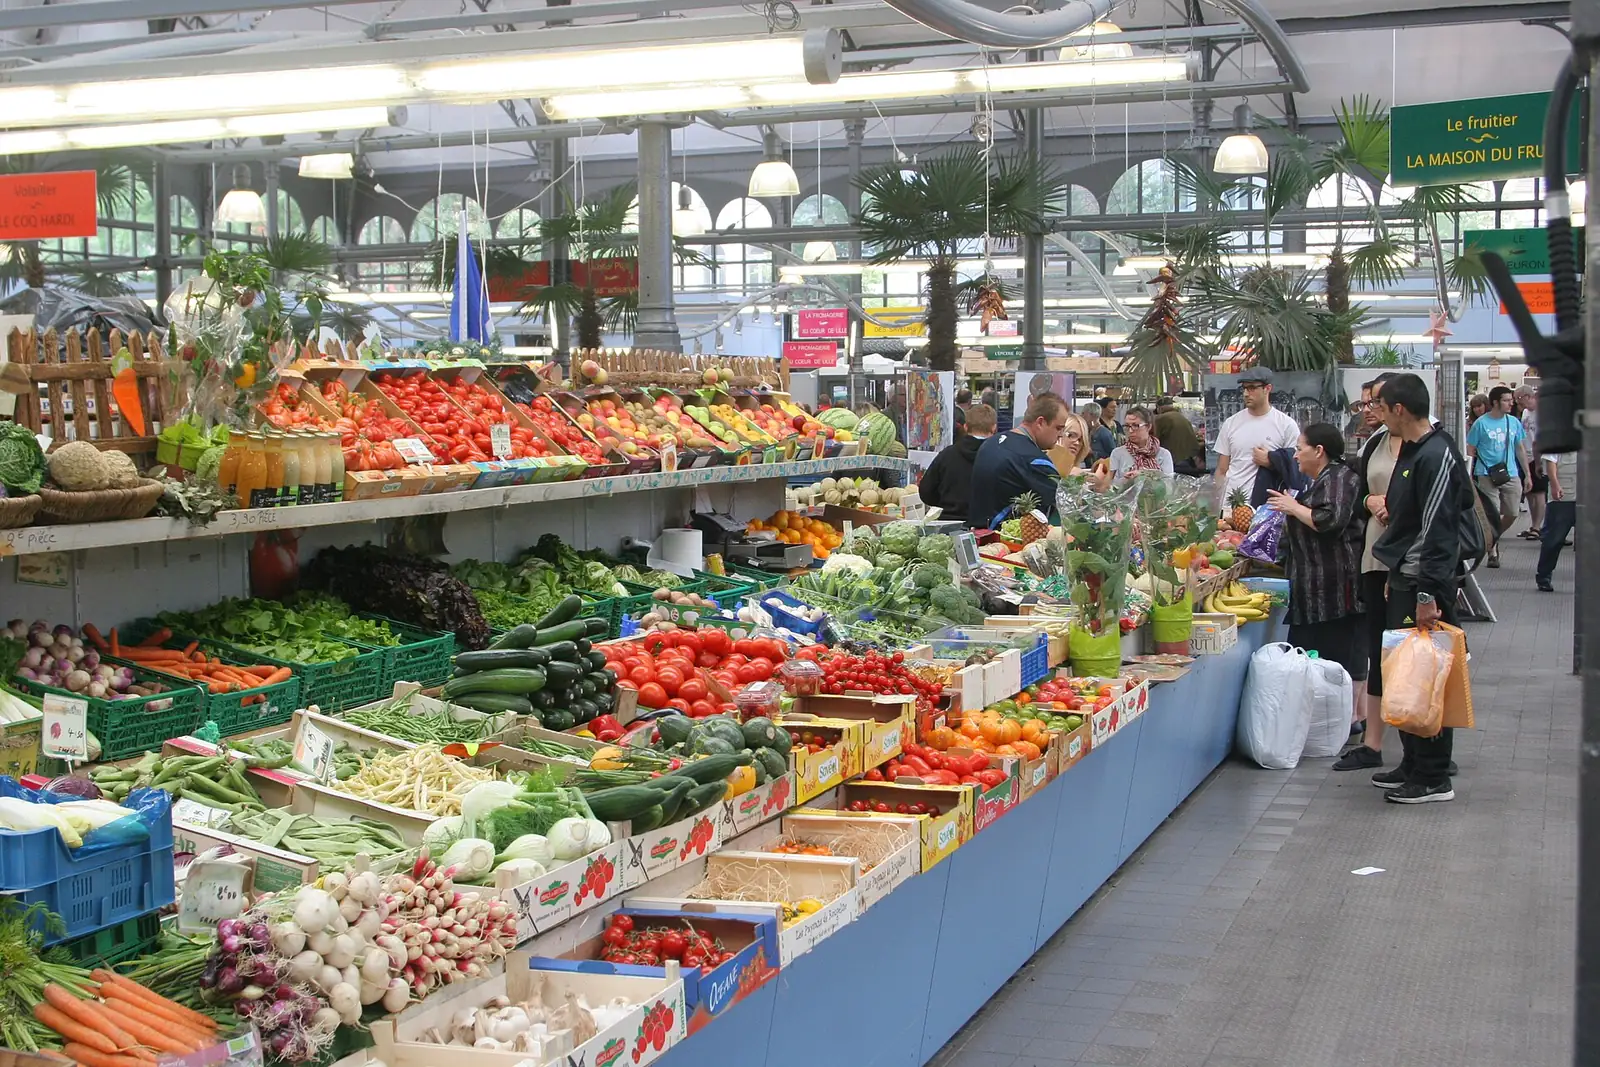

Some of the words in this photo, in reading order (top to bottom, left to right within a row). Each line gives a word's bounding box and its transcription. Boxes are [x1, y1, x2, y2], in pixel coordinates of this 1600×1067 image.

[1447, 118, 1463, 132] Le
[1468, 114, 1518, 130] fruitier
[1407, 155, 1424, 168] LA
[1429, 149, 1486, 166] MAISON
[1491, 148, 1513, 161] DU
[1518, 145, 1545, 159] FRU
[13, 215, 38, 229] COQ
[41, 213, 75, 227] HARDI
[1513, 235, 1525, 243] LE
[1507, 260, 1545, 270] EURON
